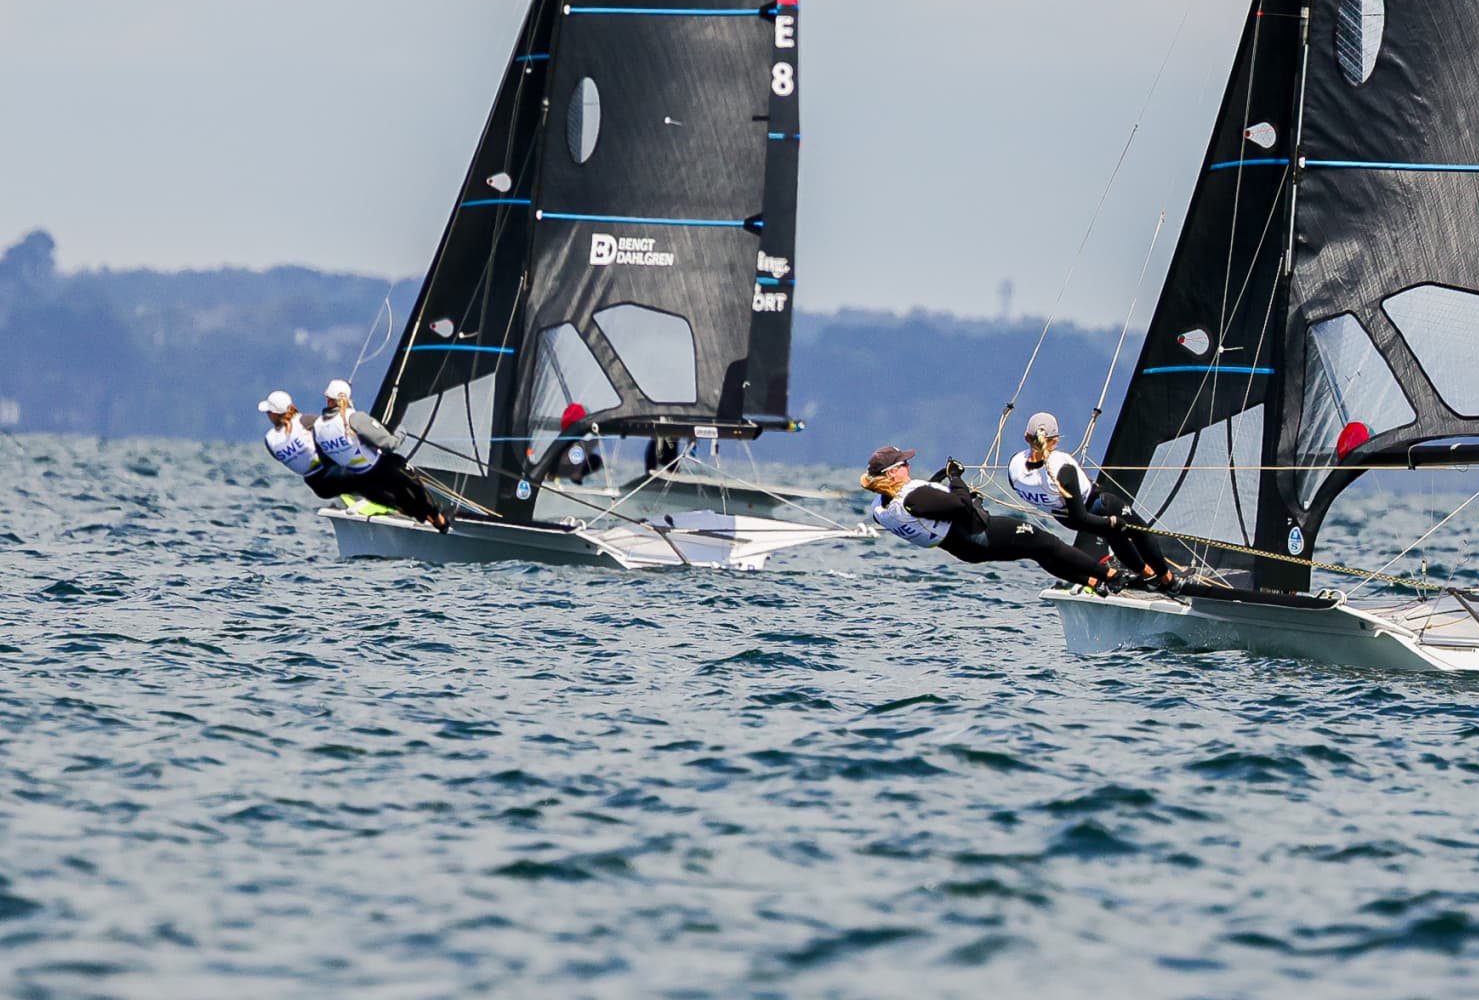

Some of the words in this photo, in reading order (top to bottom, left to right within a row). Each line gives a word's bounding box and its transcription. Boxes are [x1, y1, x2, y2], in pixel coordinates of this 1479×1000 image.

[618, 237, 657, 252] BENGT
[615, 251, 675, 267] DAHLGREN
[275, 438, 305, 460] SWE
[320, 436, 349, 451] SWE
